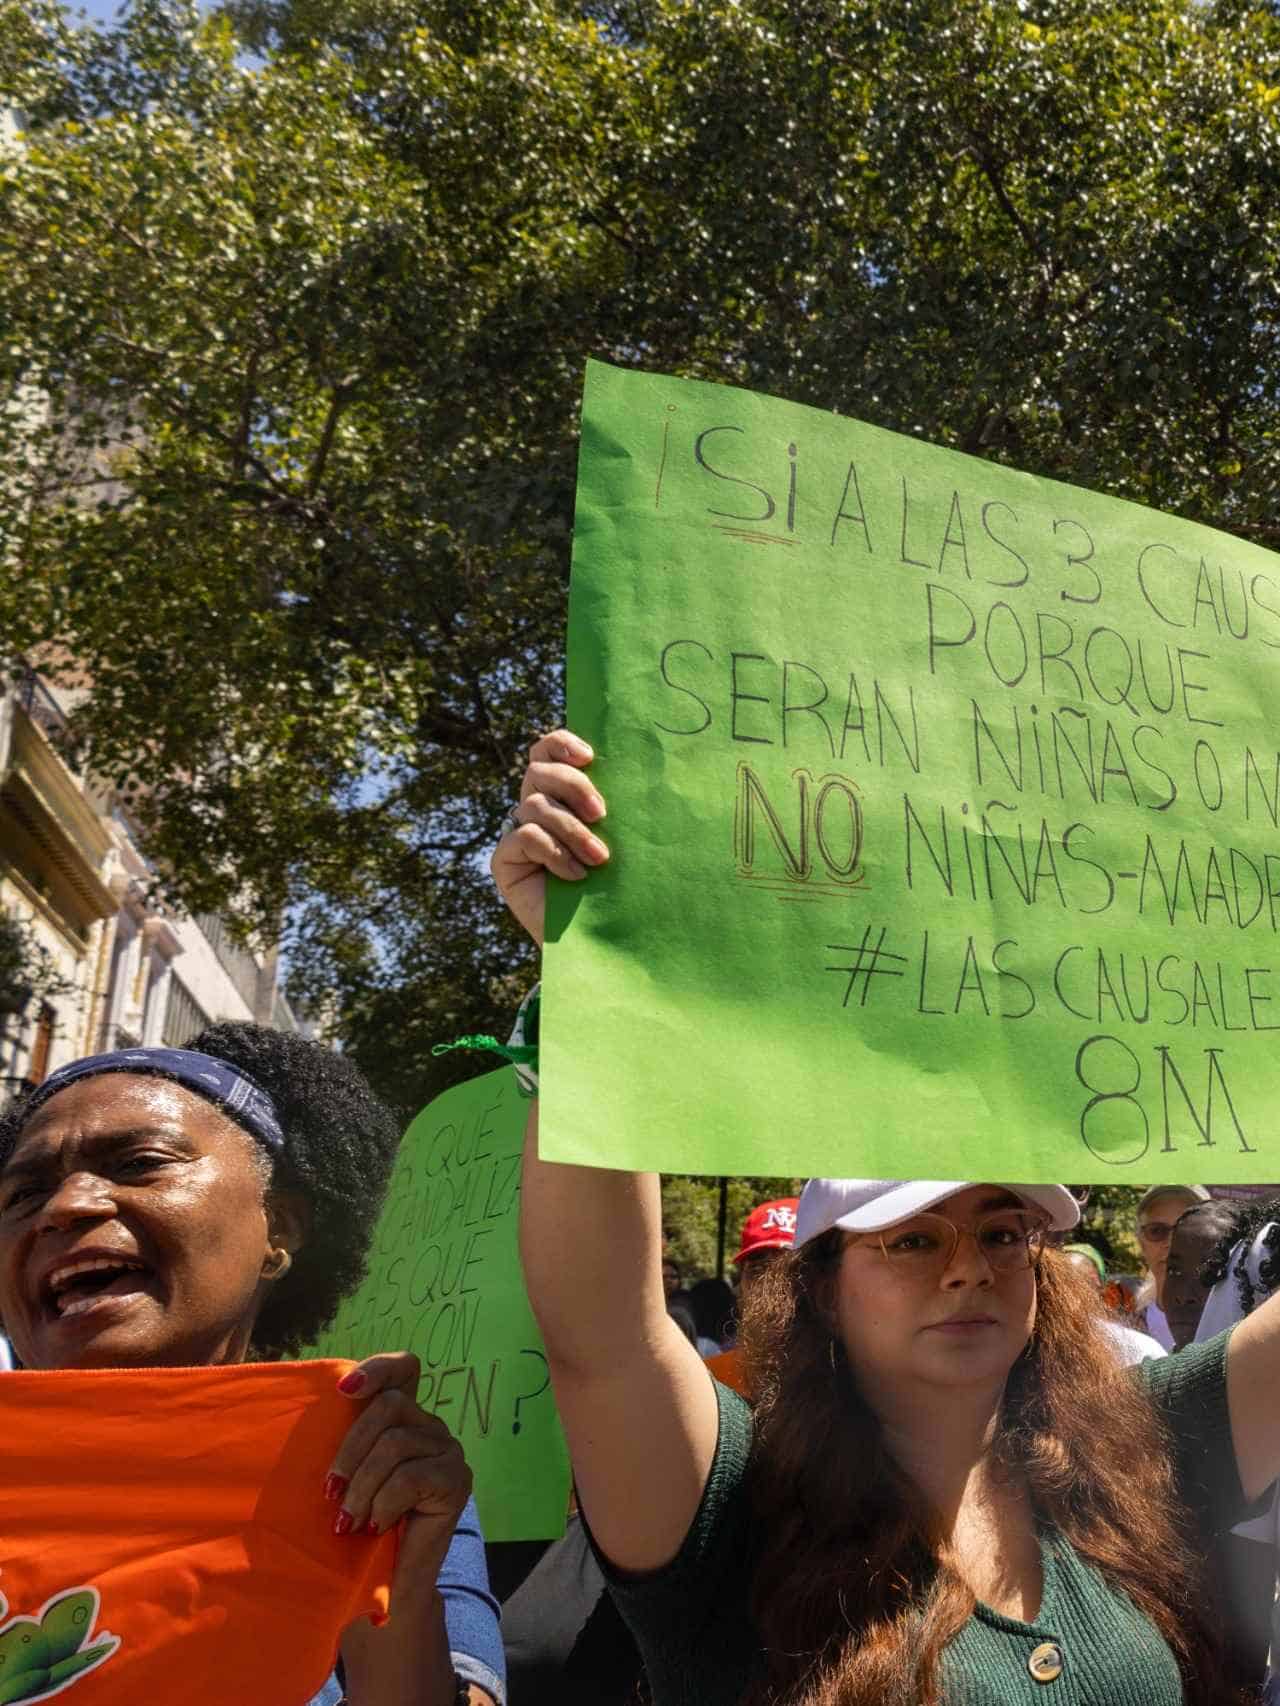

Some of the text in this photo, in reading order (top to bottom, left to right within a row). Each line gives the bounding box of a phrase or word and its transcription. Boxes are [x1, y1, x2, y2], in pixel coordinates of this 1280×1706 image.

[831, 461, 873, 554] A
[900, 475, 1029, 588] LAS
[1052, 518, 1101, 603] 3
[926, 583, 1224, 729] PORQUE
[654, 639, 920, 773] SERAN
[1194, 738, 1224, 811] O
[733, 760, 866, 884] NO
[1075, 1034, 1258, 1166] 8M
[408, 1229, 498, 1309] QUE
[409, 1296, 483, 1369] CON
